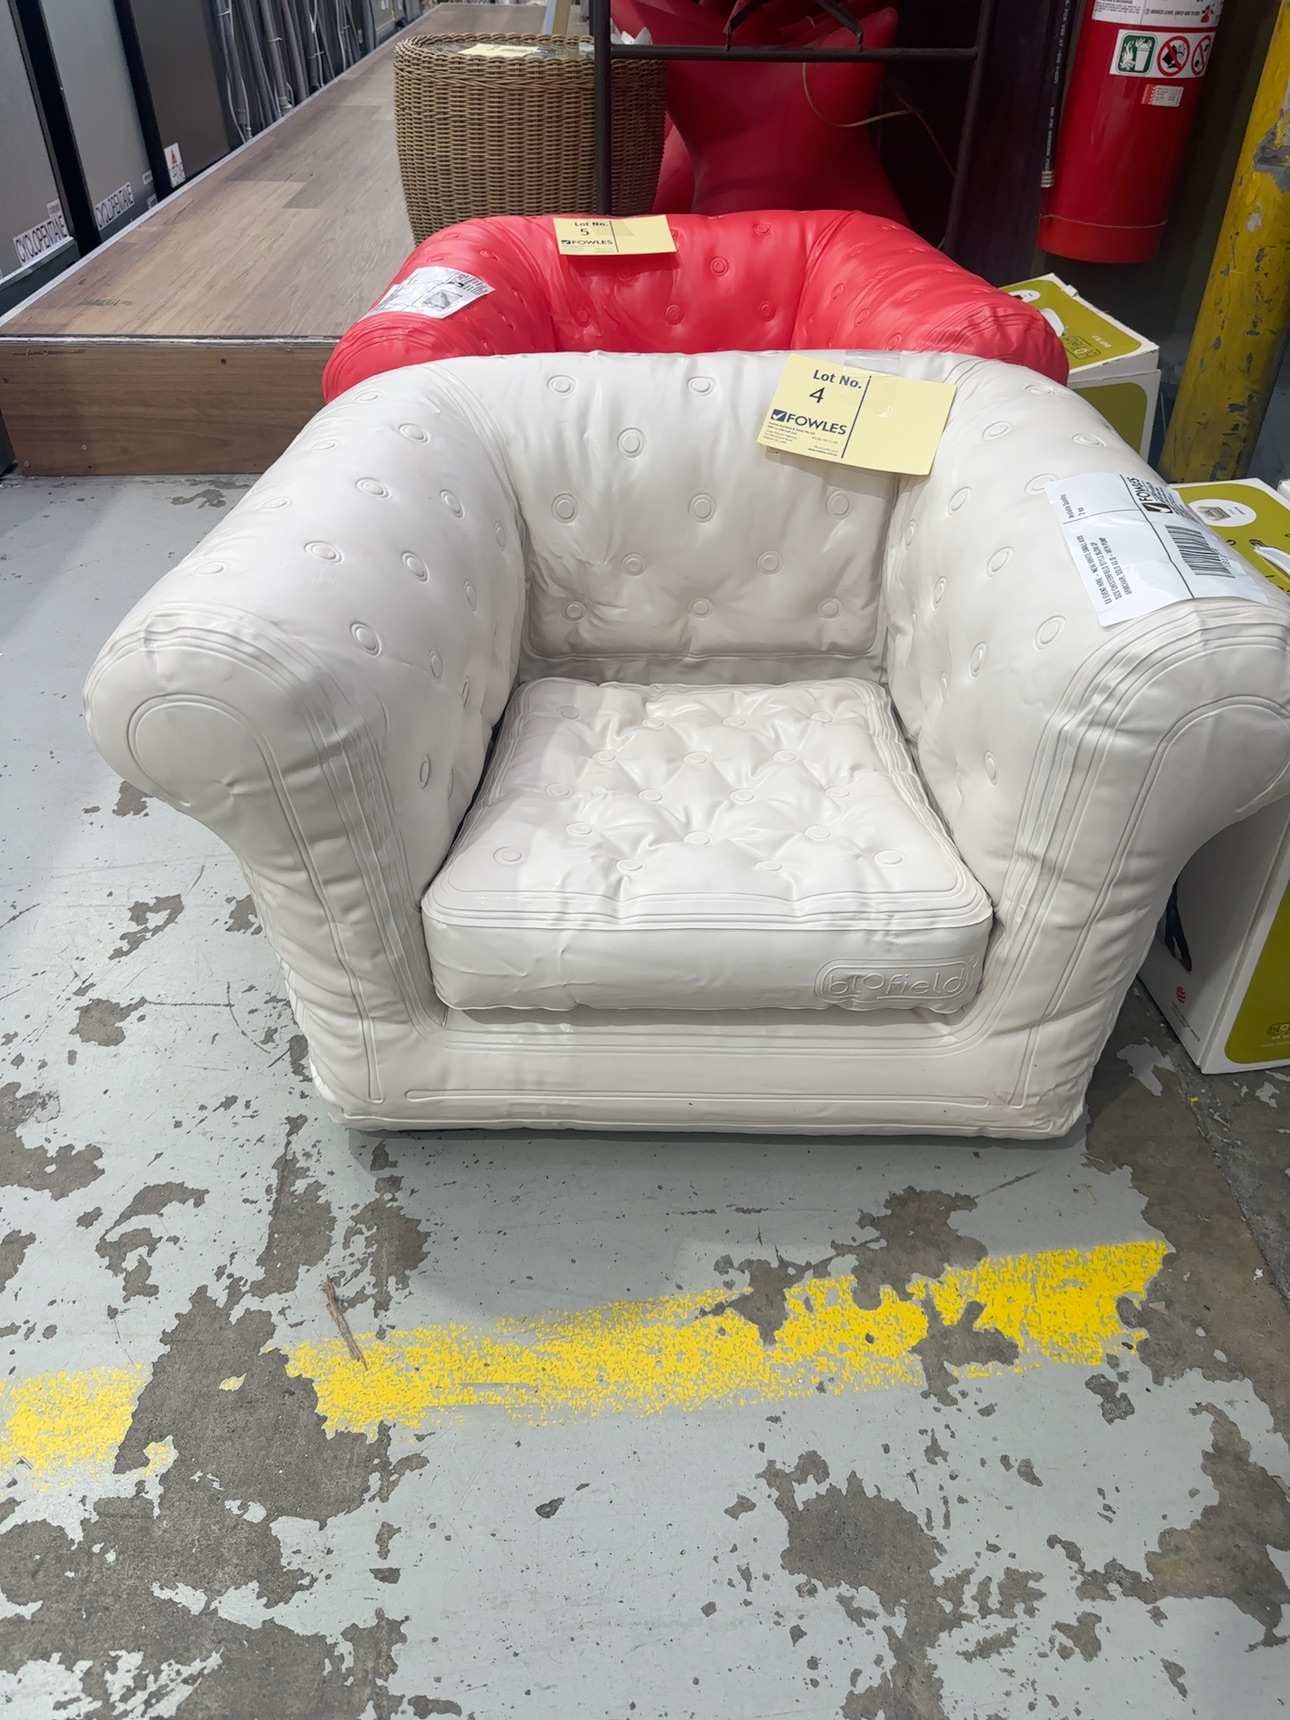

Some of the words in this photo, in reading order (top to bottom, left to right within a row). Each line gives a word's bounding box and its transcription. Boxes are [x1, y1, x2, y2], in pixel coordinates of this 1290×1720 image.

[95, 184, 134, 228] CYCLOPENTANE
[15, 215, 68, 263] CYCLOPENTANE
[580, 228, 590, 236] 5
[813, 369, 836, 383] Lot
[839, 375, 862, 389] No.
[809, 387, 826, 403] 4
[786, 413, 847, 435] FOWLES
[1127, 477, 1153, 501] FOWLES
[1089, 563, 1098, 573] NEW
[1096, 555, 1107, 565] STYLE
[1101, 565, 1118, 591] CHESTERFIELD
[1114, 565, 1123, 576] SOLD
[1095, 577, 1104, 587] HIRE
[1099, 587, 1109, 598] EVENT
[828, 968, 965, 995] blofield
